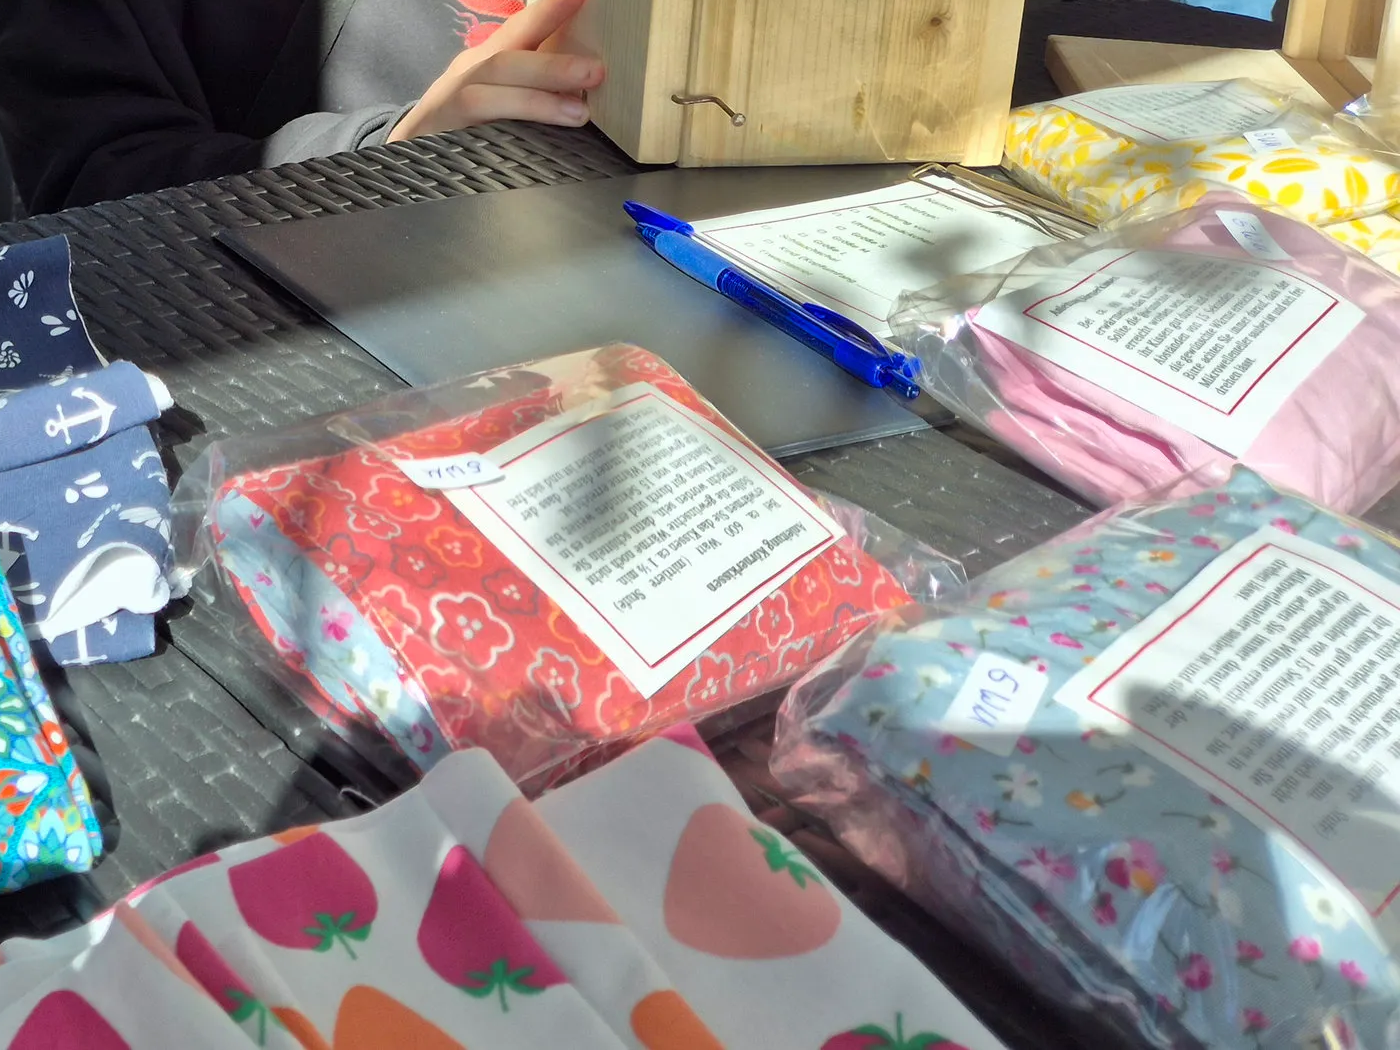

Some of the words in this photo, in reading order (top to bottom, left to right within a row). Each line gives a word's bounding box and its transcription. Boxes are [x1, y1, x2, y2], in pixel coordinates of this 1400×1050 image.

[1105, 323, 1133, 343] Sollte
[1120, 324, 1153, 350] erreicht
[1144, 325, 1174, 347] Kissen
[1150, 331, 1190, 365] Abständen
[1194, 312, 1211, 321] 15
[1135, 345, 1154, 357] ihr
[1180, 361, 1206, 380] Bitte
[1196, 342, 1225, 363] achten
[1215, 332, 1235, 344] Sie
[1195, 335, 1255, 388] Mikrowellenteller
[1165, 359, 1186, 372] die
[1211, 369, 1243, 395] drehen
[637, 476, 656, 489] 15
[666, 473, 689, 489] gut
[505, 493, 529, 510] frei
[644, 483, 677, 505] durch
[673, 481, 711, 506] worden
[713, 488, 734, 502] die
[517, 505, 543, 523] der
[626, 499, 652, 517] und
[662, 493, 720, 534] gewünschte
[709, 509, 730, 524] Sie
[628, 514, 658, 535] dann
[695, 518, 717, 534] das
[721, 520, 745, 538] 600
[761, 518, 809, 553] Anleitung
[543, 531, 567, 548] bis
[568, 539, 586, 552] es
[631, 527, 671, 556] Wärme
[667, 527, 702, 553] Kissen
[694, 536, 722, 556] Watt
[556, 547, 575, 561] in
[609, 549, 639, 571] noch
[570, 557, 594, 575] Sie
[584, 564, 616, 587] nicht
[646, 554, 693, 590] (mittlere
[705, 546, 770, 593] Körnerkissen
[1254, 557, 1290, 586] drehen
[614, 568, 642, 588] min.
[1302, 577, 1331, 600] Bitte
[611, 587, 647, 614] Stufe)
[1234, 566, 1311, 633] Mikrowellenteller
[1275, 594, 1312, 625] achten
[1328, 589, 1352, 607] die
[1261, 618, 1287, 638] Sie
[1281, 597, 1340, 647] gewünschte
[1322, 601, 1373, 645] Abständen
[1206, 626, 1245, 658] sauber
[1233, 632, 1271, 663] immer
[1305, 639, 1329, 658] von
[1344, 626, 1382, 656] Kissen
[1255, 641, 1296, 675] Wärme
[1293, 656, 1315, 672] 15
[1326, 647, 1353, 667] gut
[1176, 661, 1206, 685] und
[1307, 662, 1343, 691] durch
[1341, 657, 1383, 691] worden
[1222, 668, 1268, 706] erreicht
[1250, 666, 1303, 712] Sekunden
[1290, 685, 1320, 708] und
[1341, 673, 1398, 728] gewünschte
[1161, 708, 1190, 732] der
[1301, 705, 1335, 733] dann
[1202, 736, 1231, 759] bis
[1313, 722, 1356, 759] Wärme
[1353, 722, 1392, 756] Kissen
[1225, 755, 1247, 772] in
[1246, 766, 1275, 789] Sie
[1268, 773, 1302, 804] nicht
